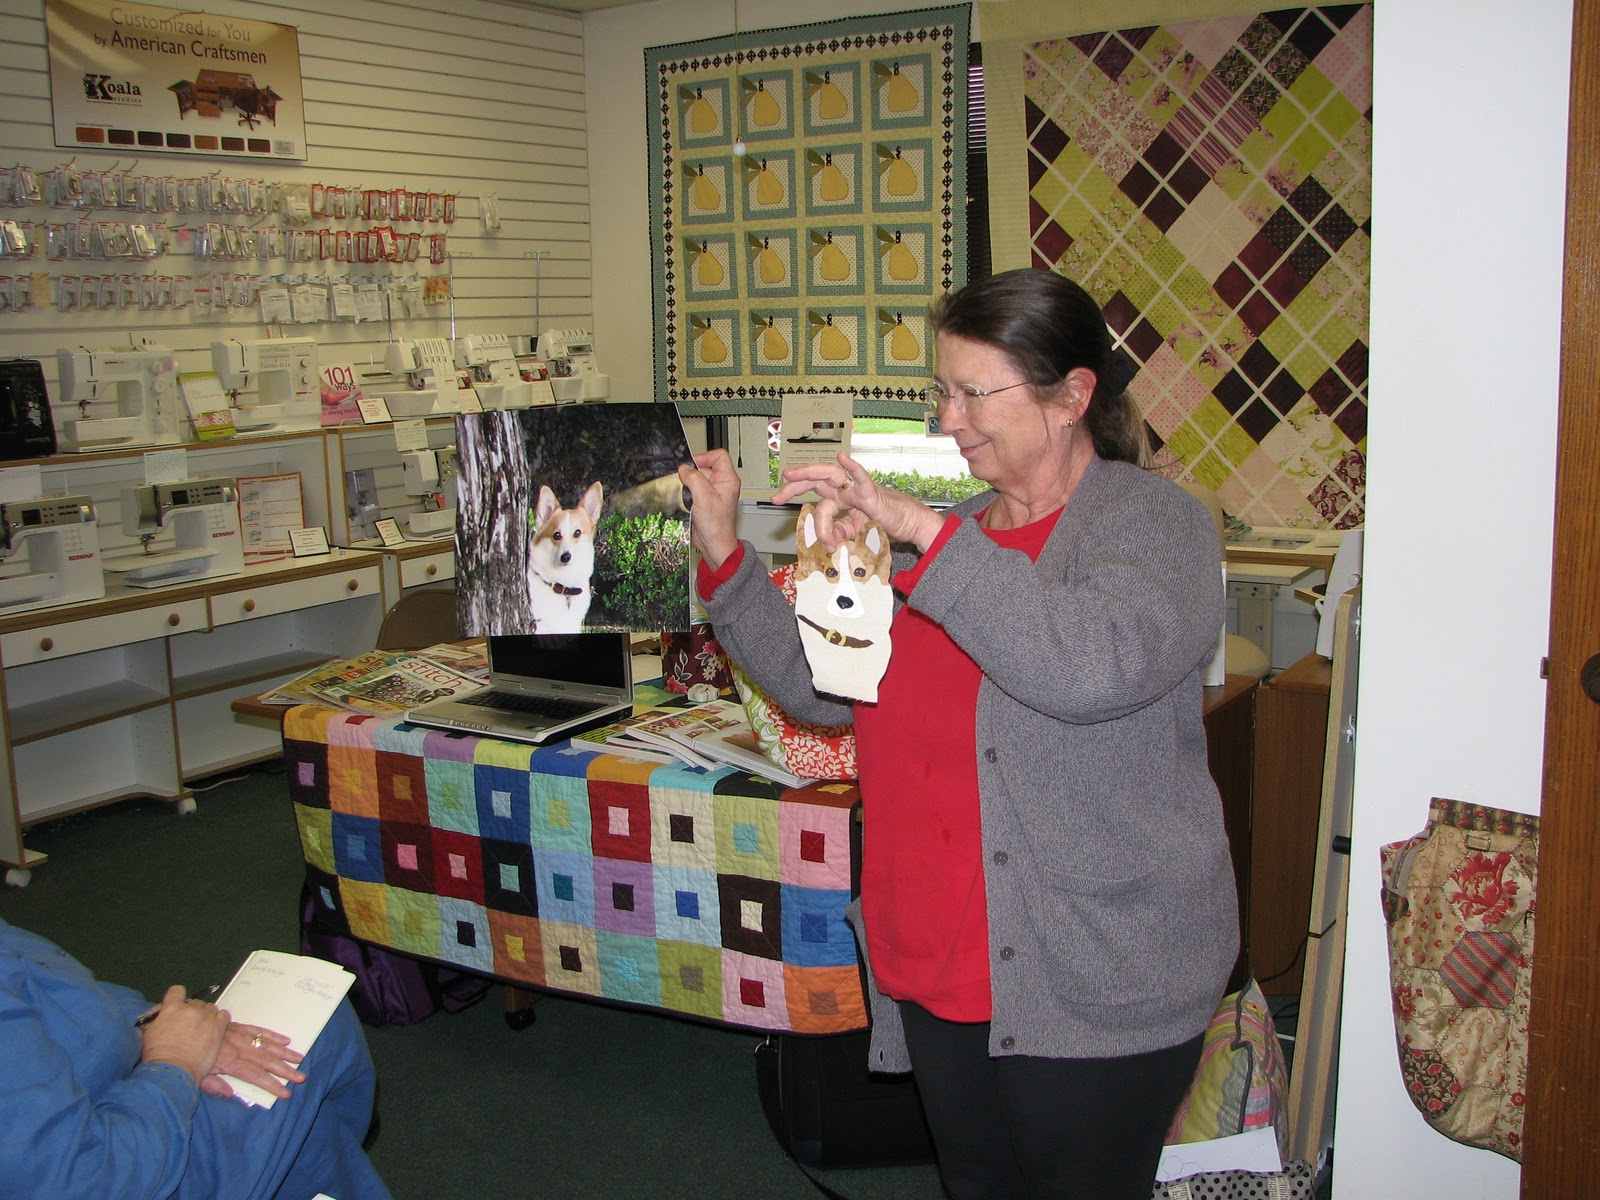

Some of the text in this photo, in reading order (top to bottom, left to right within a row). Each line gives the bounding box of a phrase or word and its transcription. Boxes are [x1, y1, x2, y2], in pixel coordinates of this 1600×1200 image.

[110, 7, 251, 42] Customized for You
[94, 30, 267, 64] by American Craftsmen
[83, 73, 142, 100] Koala
[324, 366, 355, 386] 101
[334, 382, 356, 392] ways
[401, 661, 464, 689] stitch
